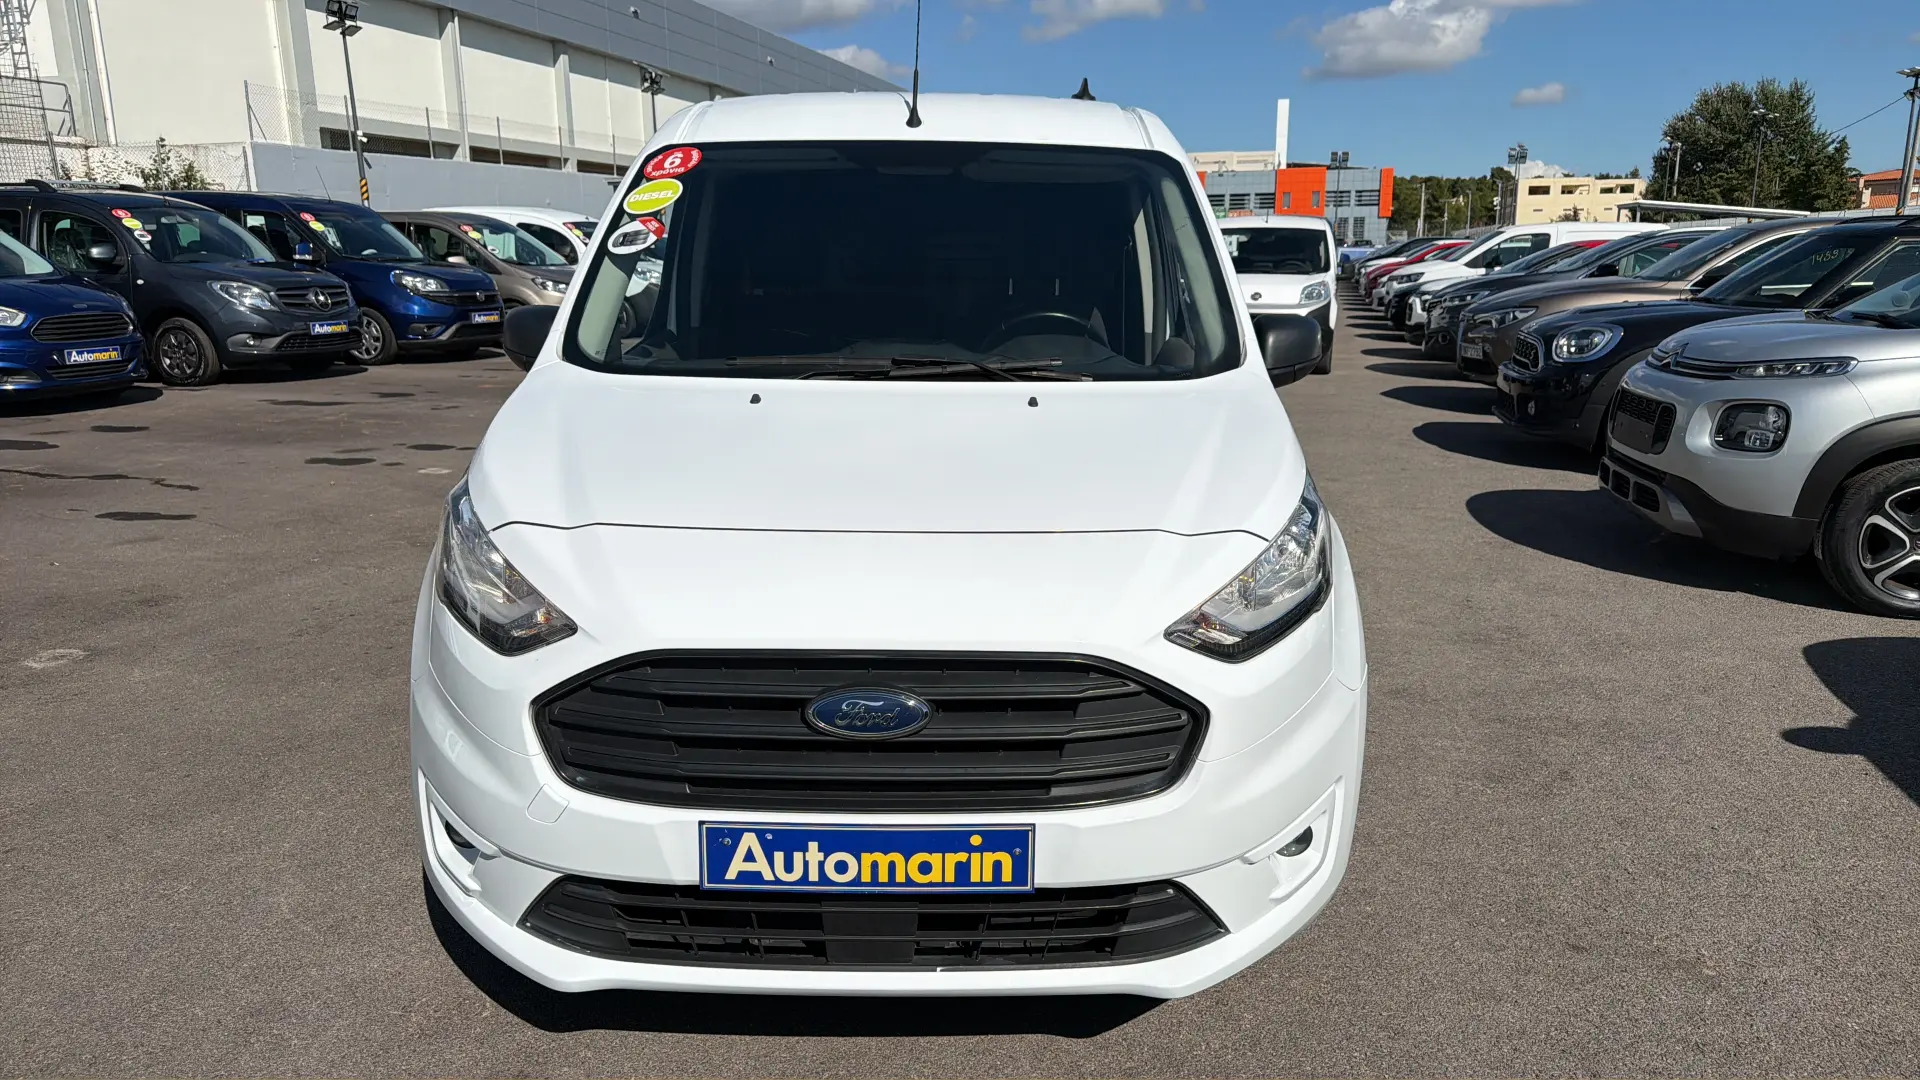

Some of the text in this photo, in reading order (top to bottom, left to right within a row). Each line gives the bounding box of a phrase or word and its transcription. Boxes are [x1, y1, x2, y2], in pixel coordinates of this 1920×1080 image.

[664, 152, 683, 168] 6
[628, 190, 676, 203] DIESEL
[314, 321, 347, 334] Automarin
[70, 347, 118, 363] Automarin
[834, 699, 900, 728] Ford
[724, 832, 1012, 884] Automarin
